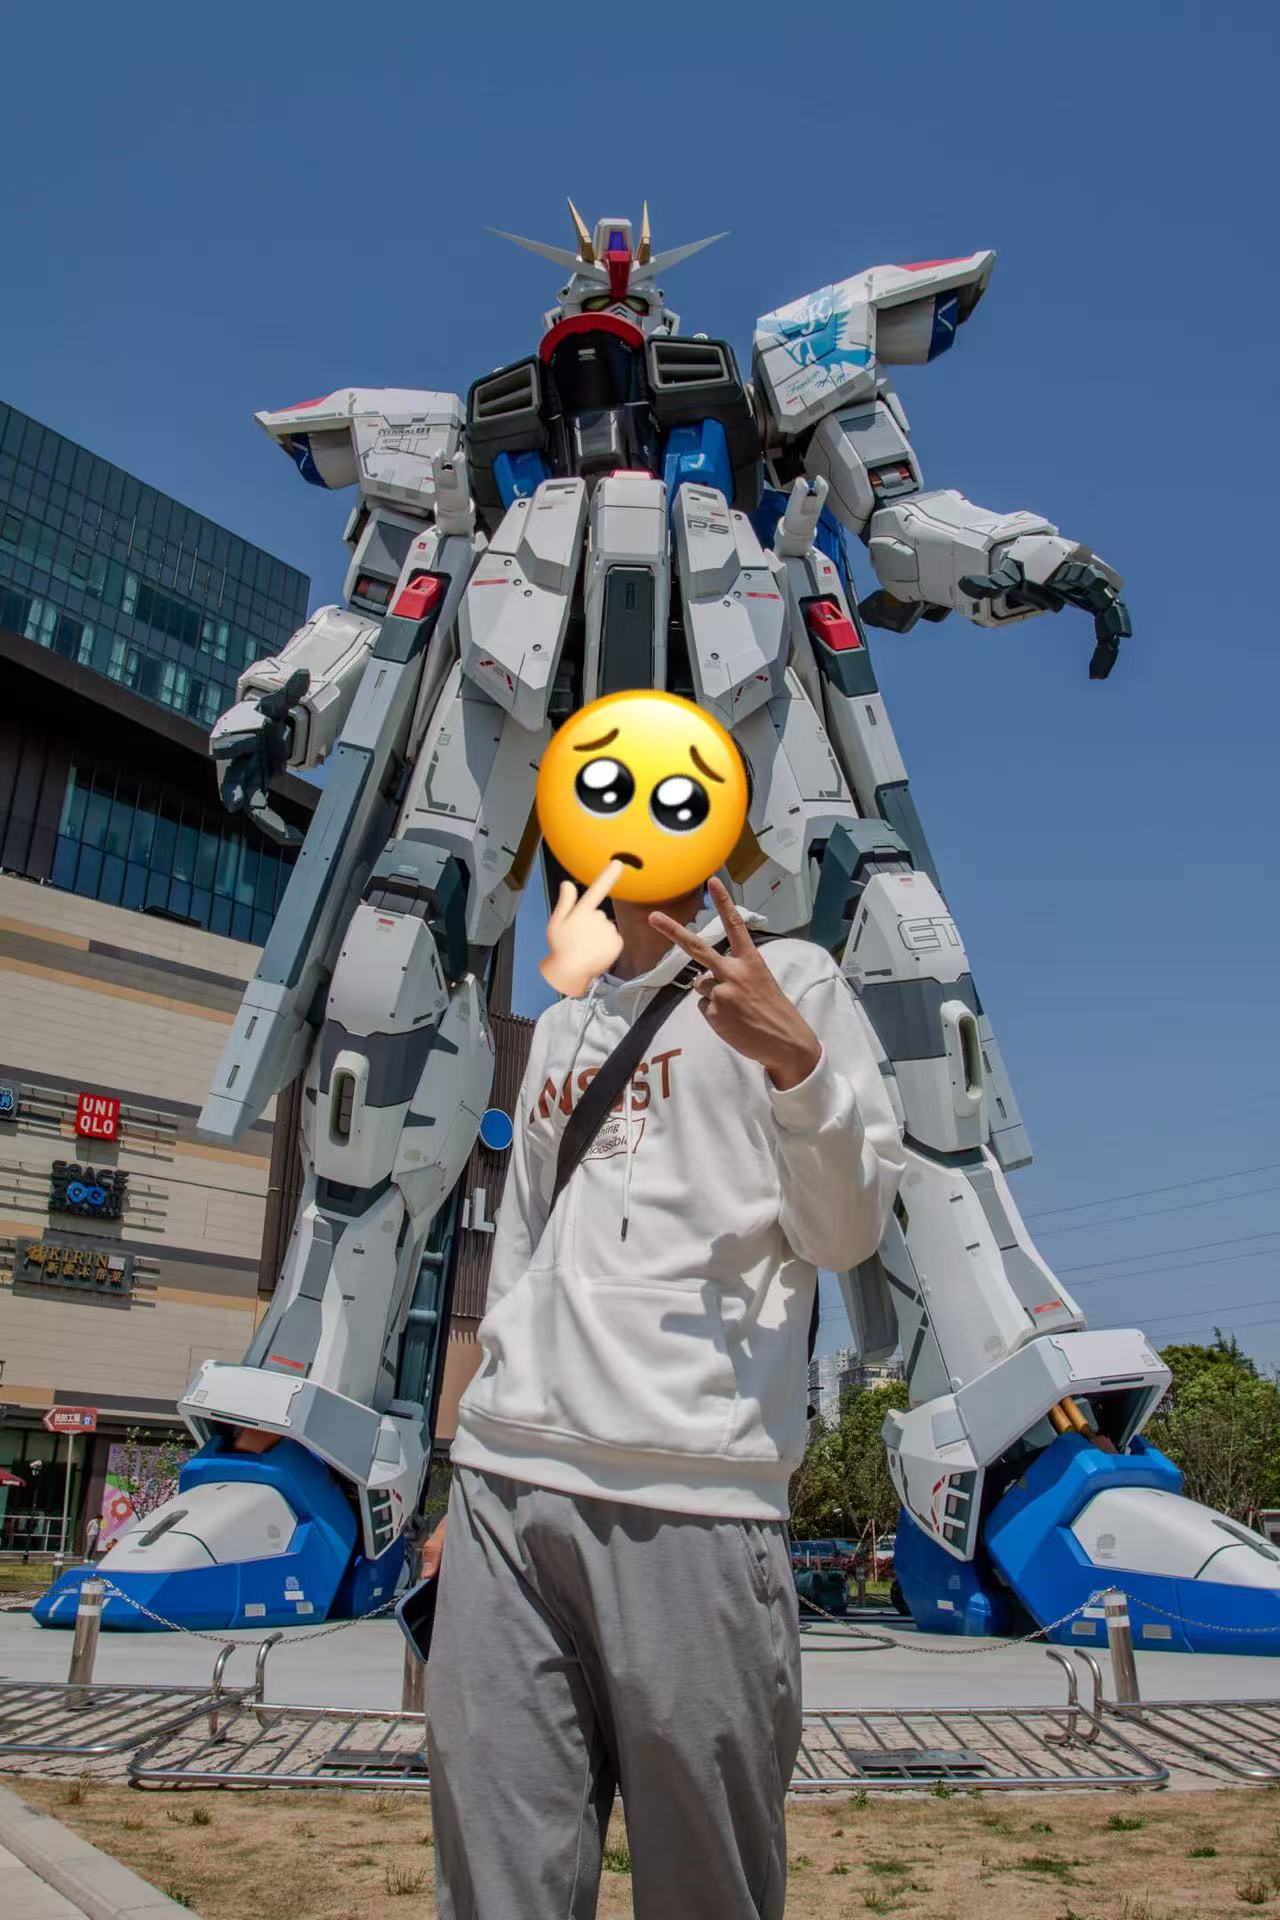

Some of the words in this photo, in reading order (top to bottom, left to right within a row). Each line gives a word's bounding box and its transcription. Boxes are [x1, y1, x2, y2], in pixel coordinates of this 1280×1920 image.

[687, 519, 729, 535] PS
[82, 1096, 114, 1117] UNI
[80, 1114, 114, 1135] QLO
[48, 1247, 109, 1269] KIRIN
